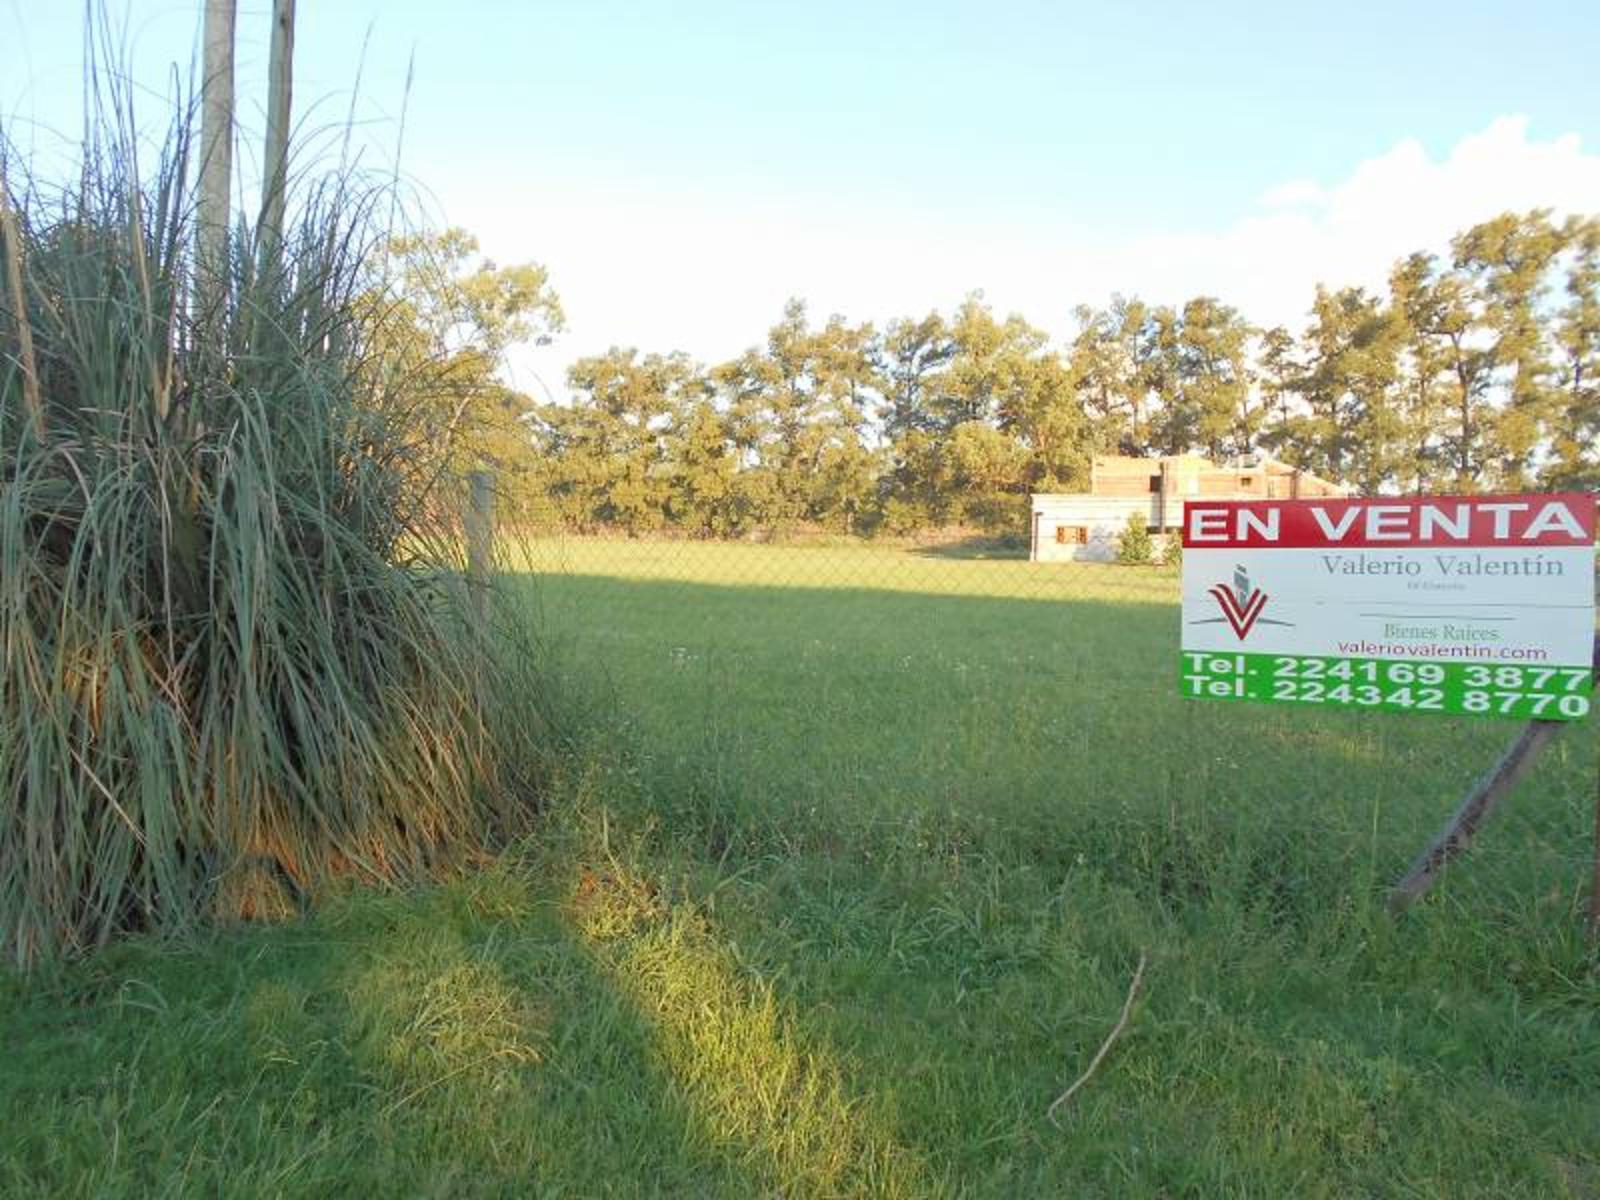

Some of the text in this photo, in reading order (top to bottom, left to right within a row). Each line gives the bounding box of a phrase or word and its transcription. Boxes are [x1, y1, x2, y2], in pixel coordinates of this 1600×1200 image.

[1189, 502, 1588, 541] EN VENTA
[1322, 554, 1565, 577] Valerio Valentín
[1383, 623, 1437, 640] Bienes
[1184, 653, 1591, 691] Tel. 224169 3877
[1184, 675, 1590, 718] Tel. 224342 8770
